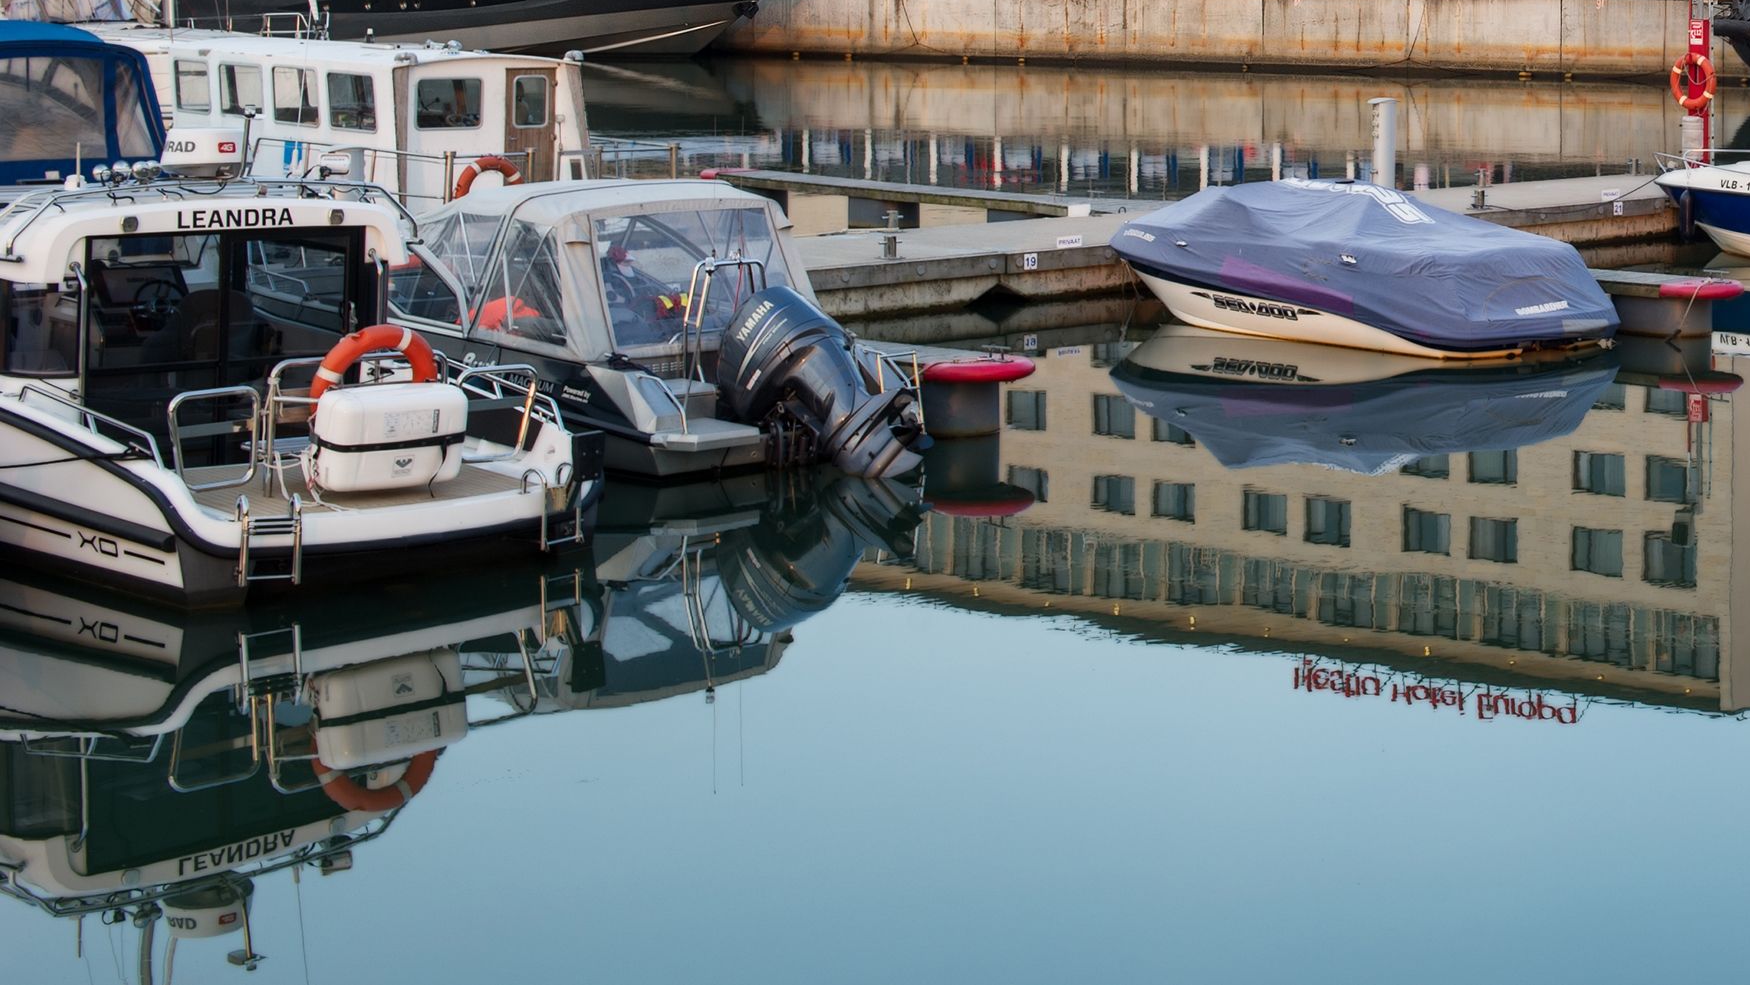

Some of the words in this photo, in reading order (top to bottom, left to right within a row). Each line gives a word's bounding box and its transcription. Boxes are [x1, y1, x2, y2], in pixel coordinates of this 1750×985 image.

[165, 141, 196, 153] RAD
[1720, 179, 1738, 190] VLB
[177, 207, 294, 229] LEANDRA
[1025, 257, 1037, 267] 19
[736, 300, 775, 342] YAMAHA
[508, 374, 555, 394] MAGUM
[78, 530, 119, 558] XO
